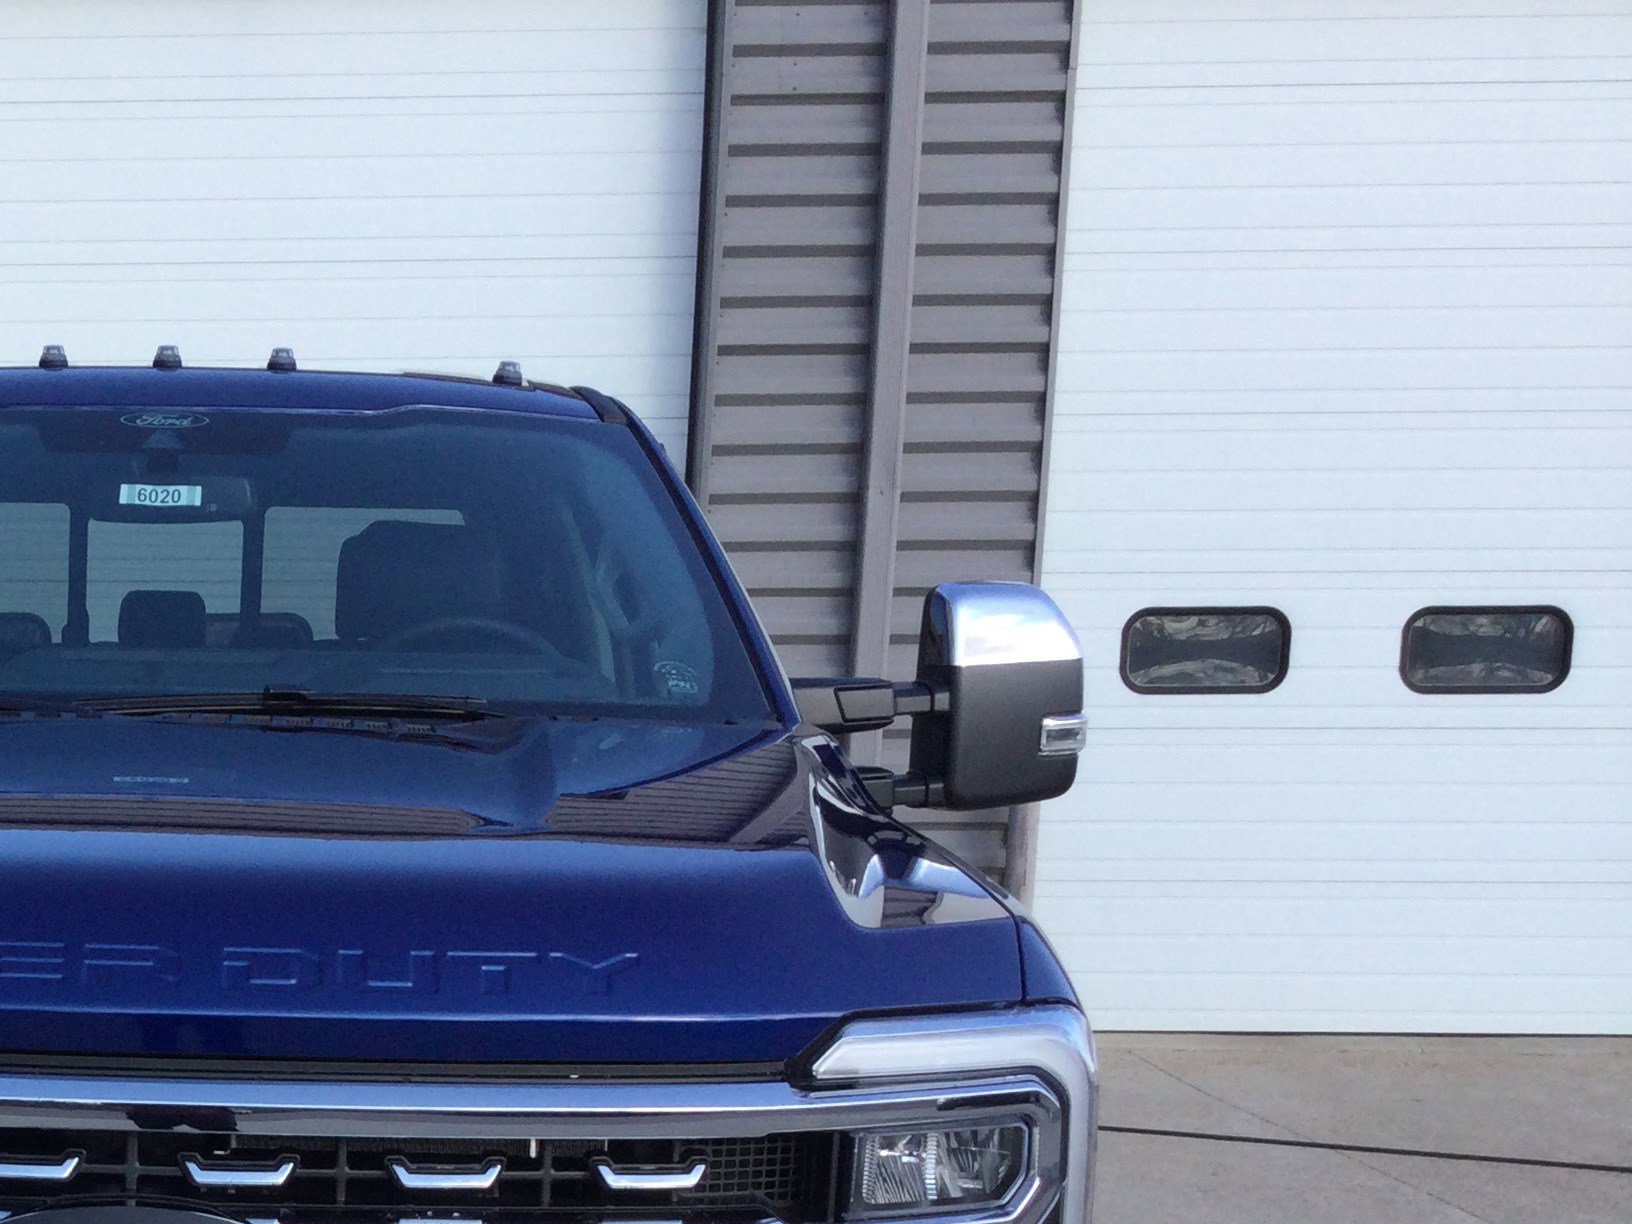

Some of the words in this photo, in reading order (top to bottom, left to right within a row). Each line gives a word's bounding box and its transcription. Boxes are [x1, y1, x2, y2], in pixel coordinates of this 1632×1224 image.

[136, 413, 194, 426] Ford
[137, 487, 182, 504] 6020
[222, 945, 640, 995] DUTY
